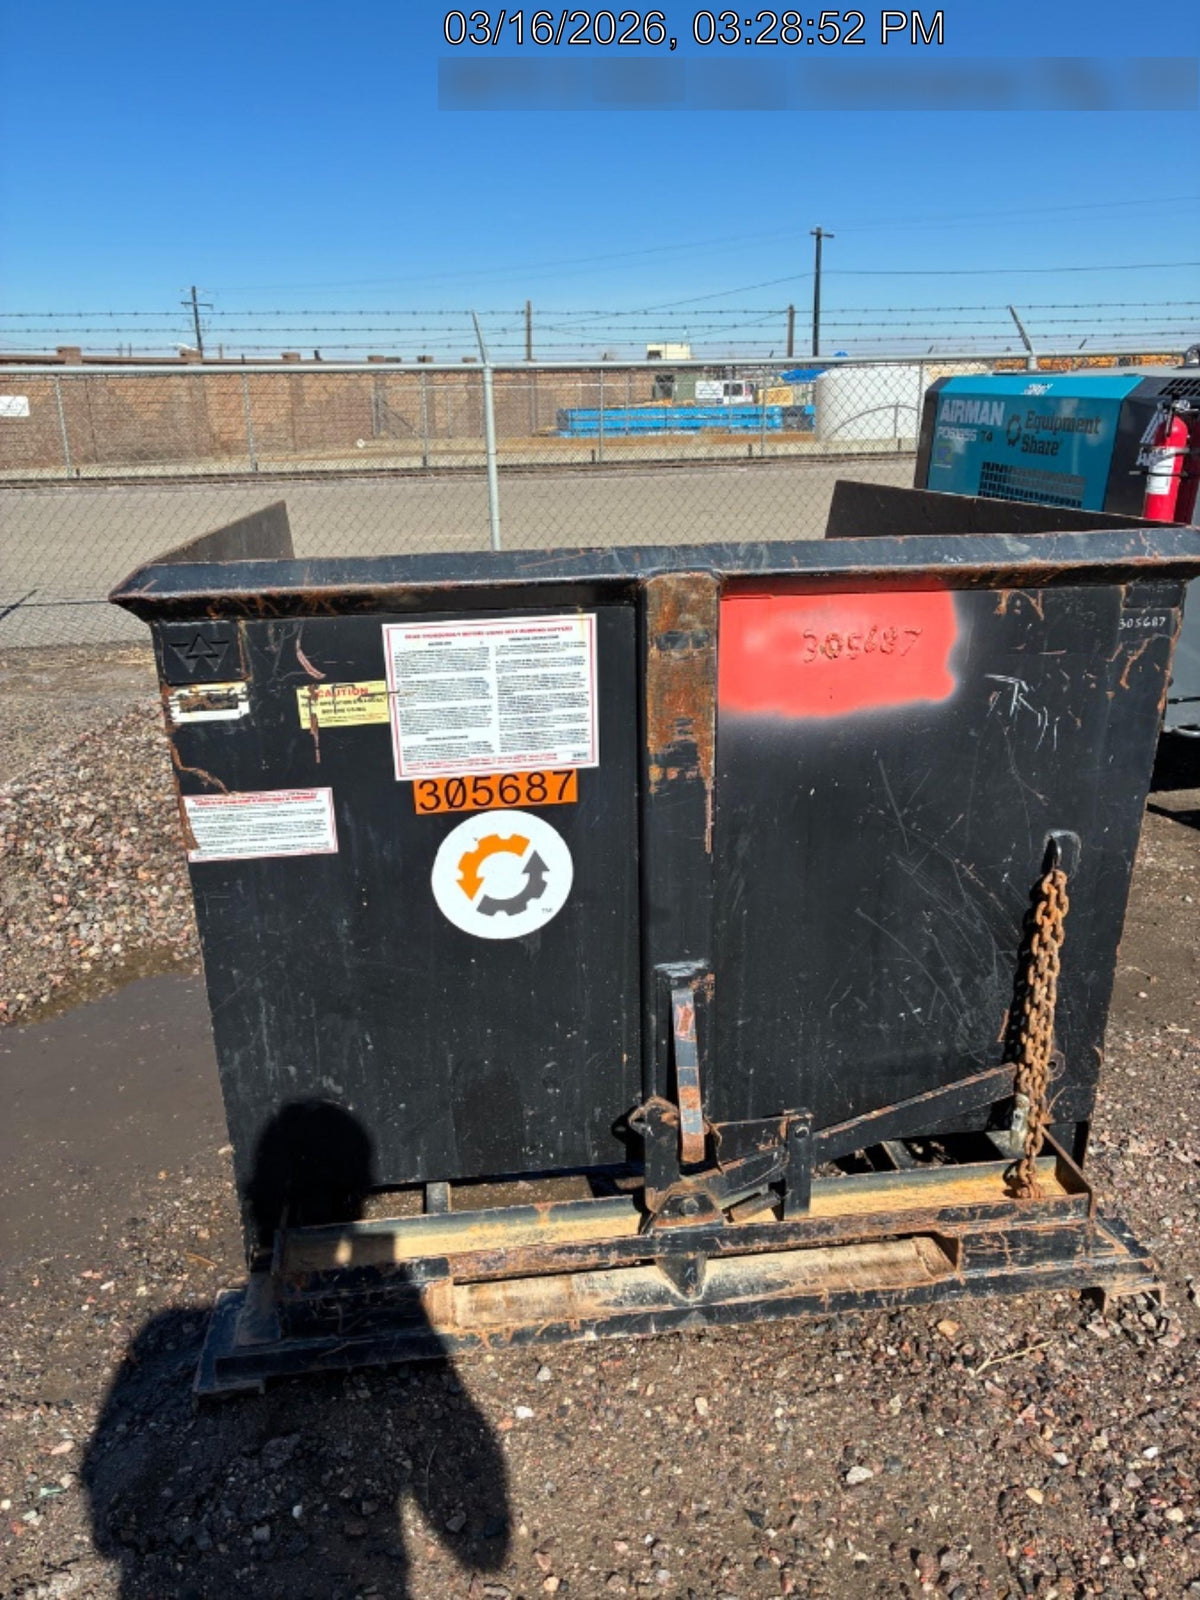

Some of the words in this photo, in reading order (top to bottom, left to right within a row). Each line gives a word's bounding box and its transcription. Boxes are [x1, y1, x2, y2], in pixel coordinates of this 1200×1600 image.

[940, 399, 1005, 426] AIRMAN
[1025, 410, 1101, 435] Equipment
[1021, 434, 1060, 456] Share
[1118, 616, 1167, 630] 305687
[802, 625, 923, 663] 305687
[315, 687, 369, 698] CAUTION
[418, 770, 574, 811] 305687
